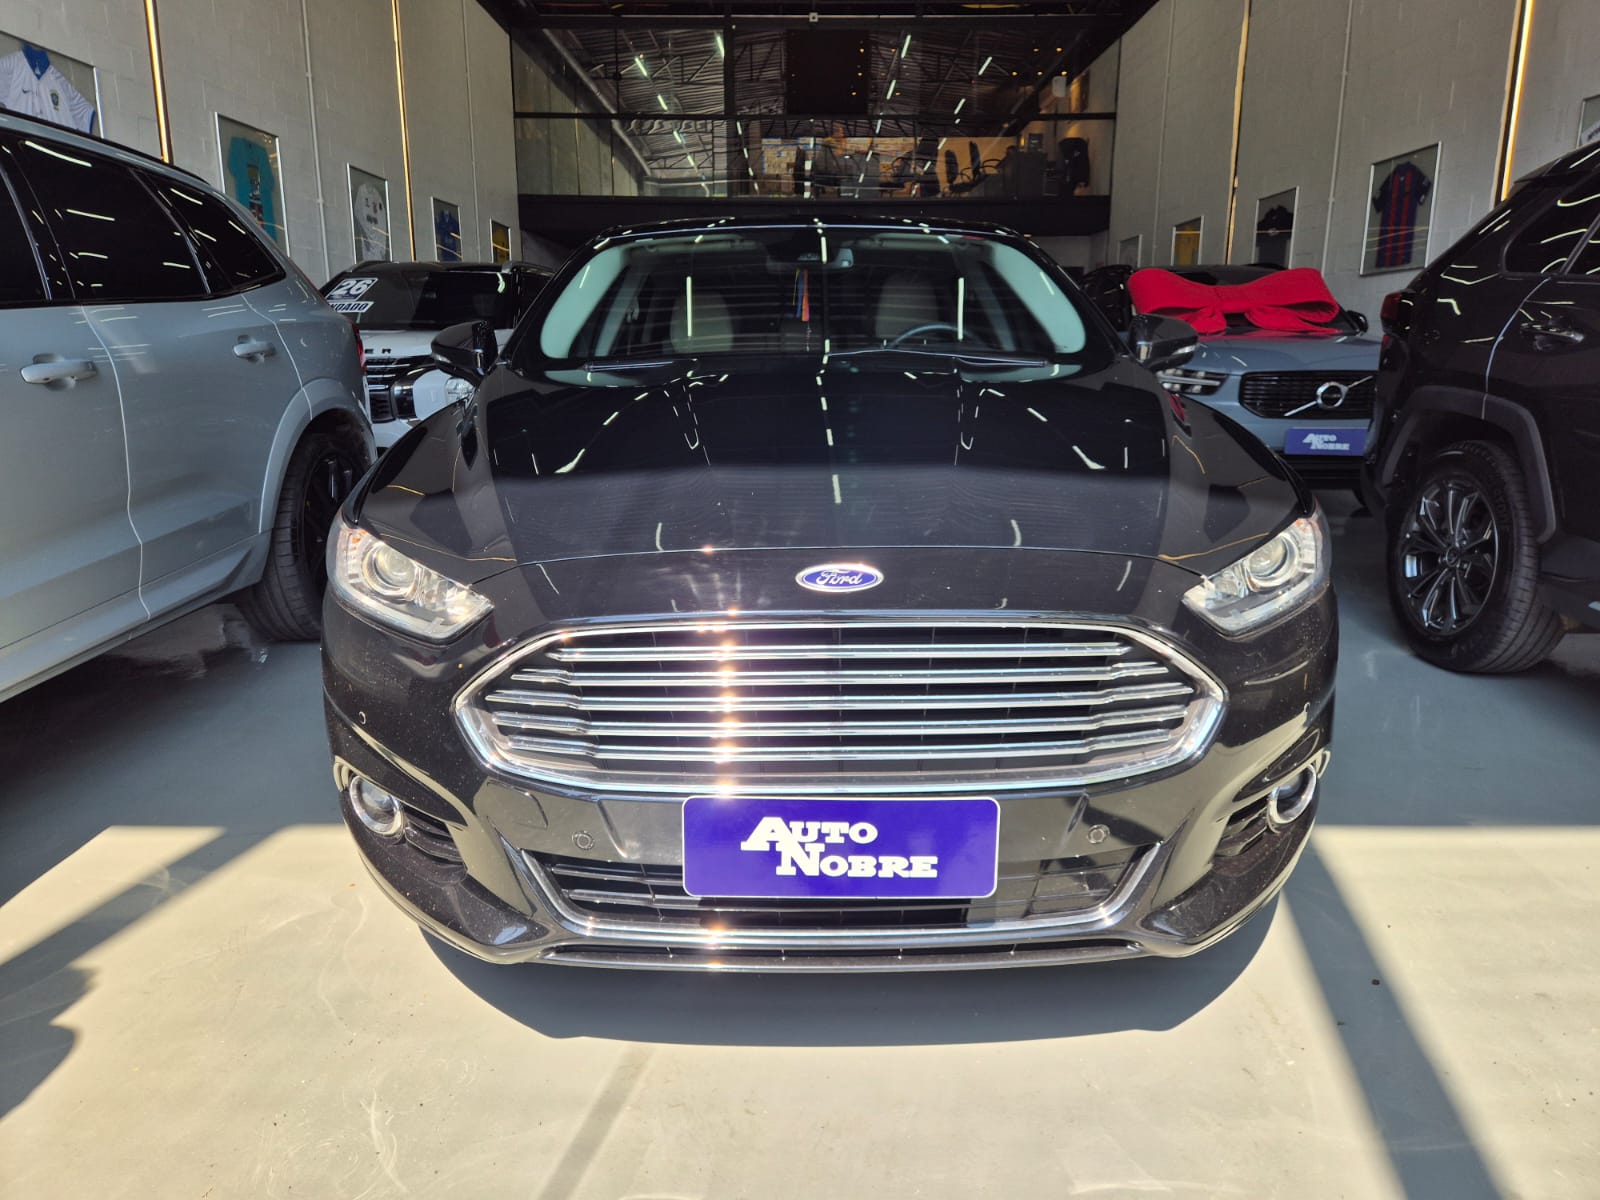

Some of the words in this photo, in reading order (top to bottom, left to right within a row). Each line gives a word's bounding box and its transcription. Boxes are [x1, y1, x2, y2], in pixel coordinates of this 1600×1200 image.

[333, 279, 372, 295] 26
[816, 568, 863, 585] Ford
[740, 816, 878, 851] AUTO
[775, 842, 938, 878] NOBRE
